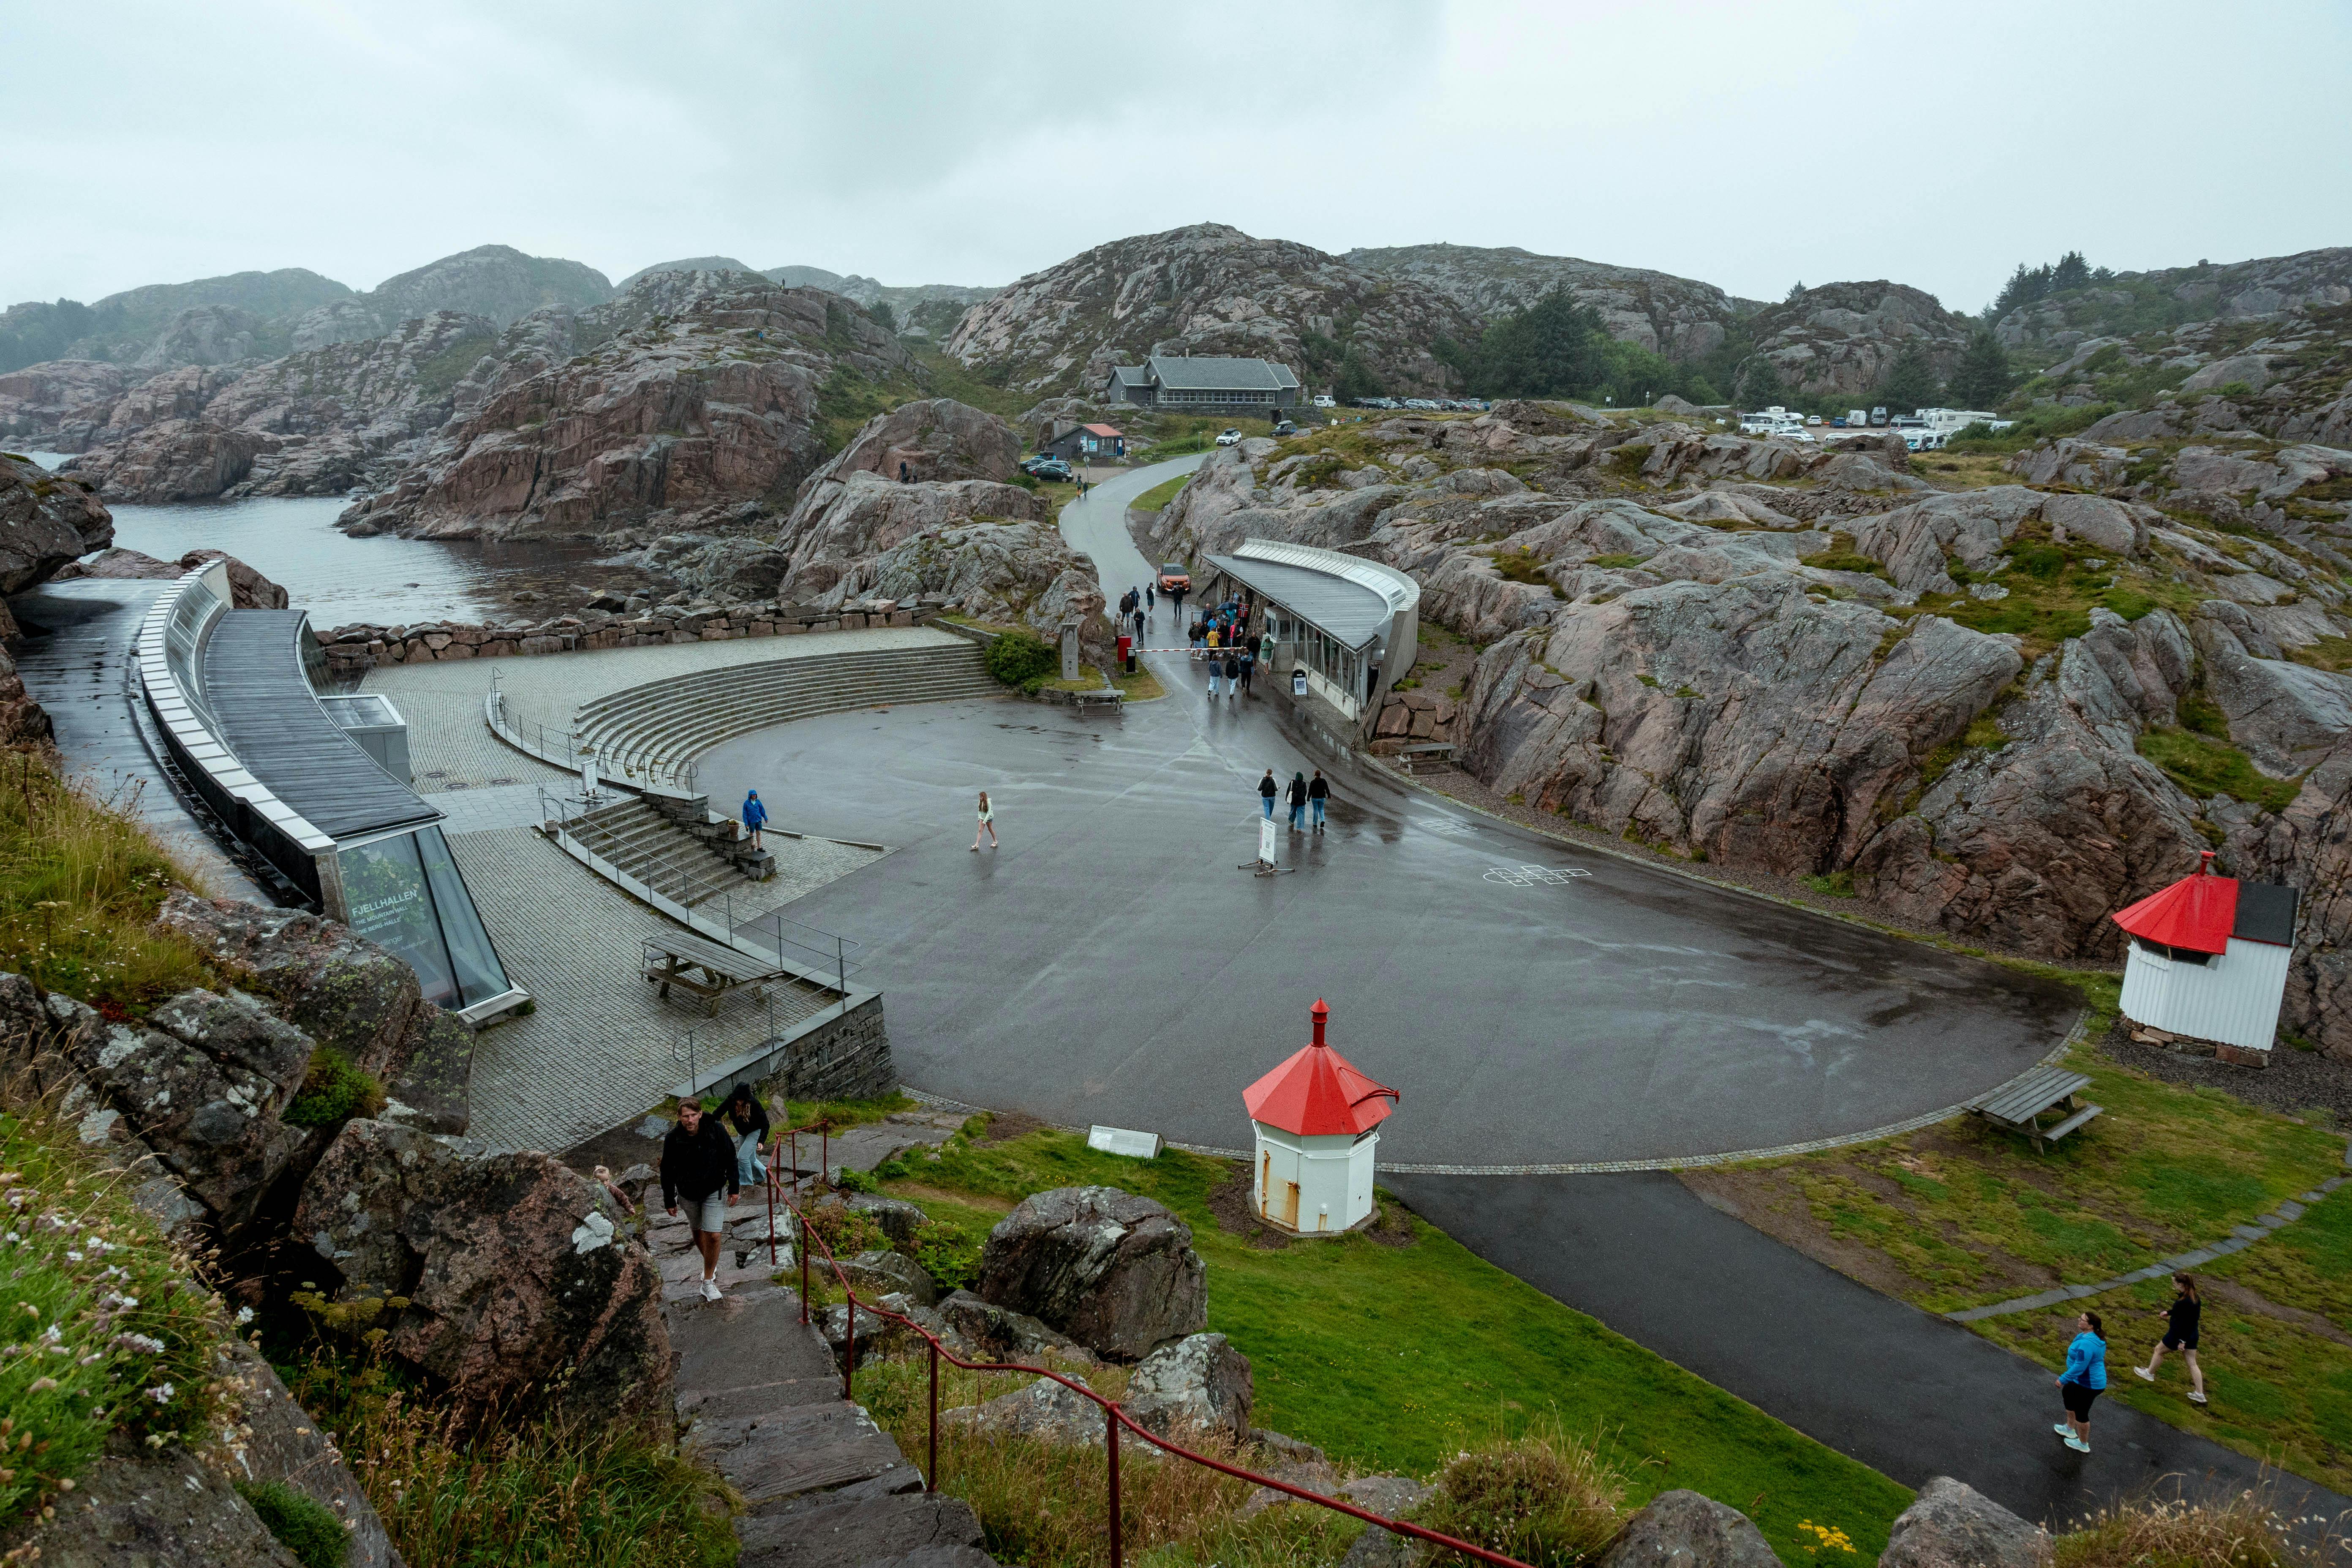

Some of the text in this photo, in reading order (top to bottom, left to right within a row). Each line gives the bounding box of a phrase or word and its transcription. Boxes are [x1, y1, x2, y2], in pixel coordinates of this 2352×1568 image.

[351, 889, 417, 917] FJELLHALLEN
[367, 909, 395, 922] MOUNTAIN
[395, 905, 408, 913] HALL
[368, 917, 401, 932] BERG-HALLE
